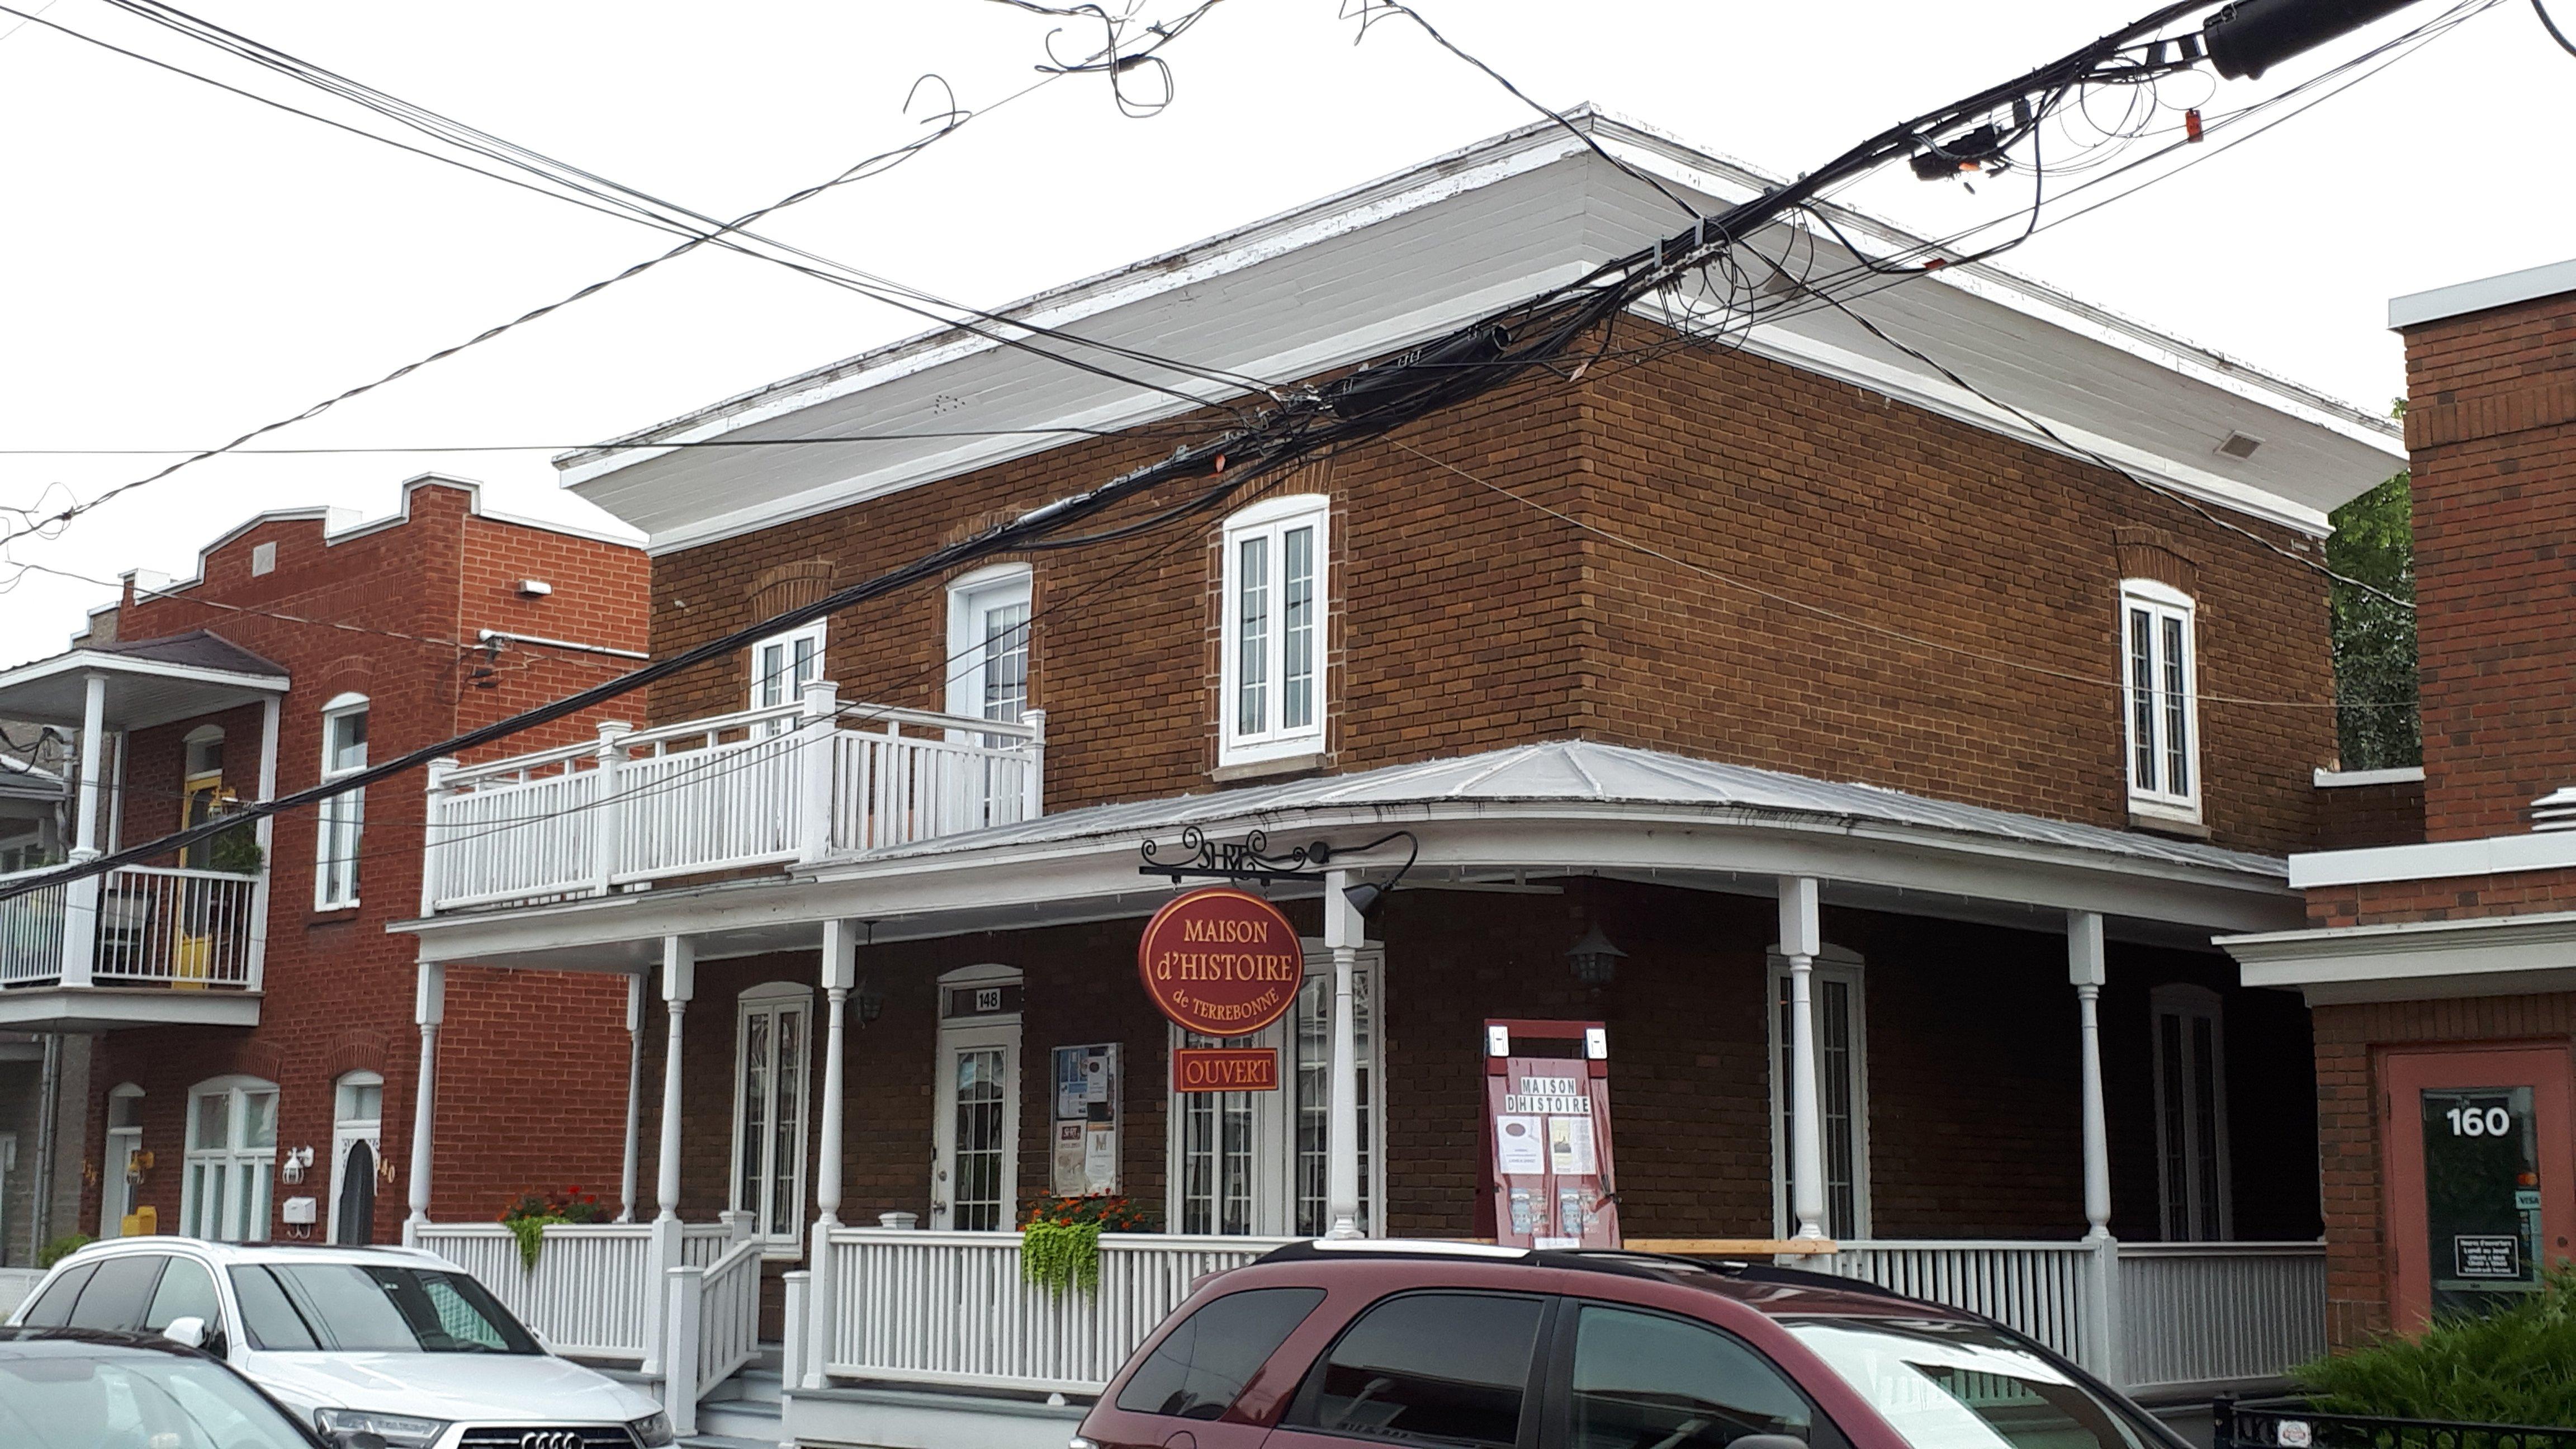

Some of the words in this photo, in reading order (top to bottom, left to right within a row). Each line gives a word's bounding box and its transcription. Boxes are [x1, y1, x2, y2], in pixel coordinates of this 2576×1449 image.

[1183, 918, 1268, 944] MAISON
[1157, 951, 1294, 982] d'HISTOIRE
[979, 992, 997, 1007] 148
[1173, 988, 1189, 1008] de
[1192, 987, 1280, 1021] TERREBONNE
[1186, 1059, 1271, 1085] OUVERT
[1522, 1078, 1575, 1094] MAISON
[1508, 1096, 1589, 1112] DHISTOIRE
[2446, 1107, 2510, 1136] 160
